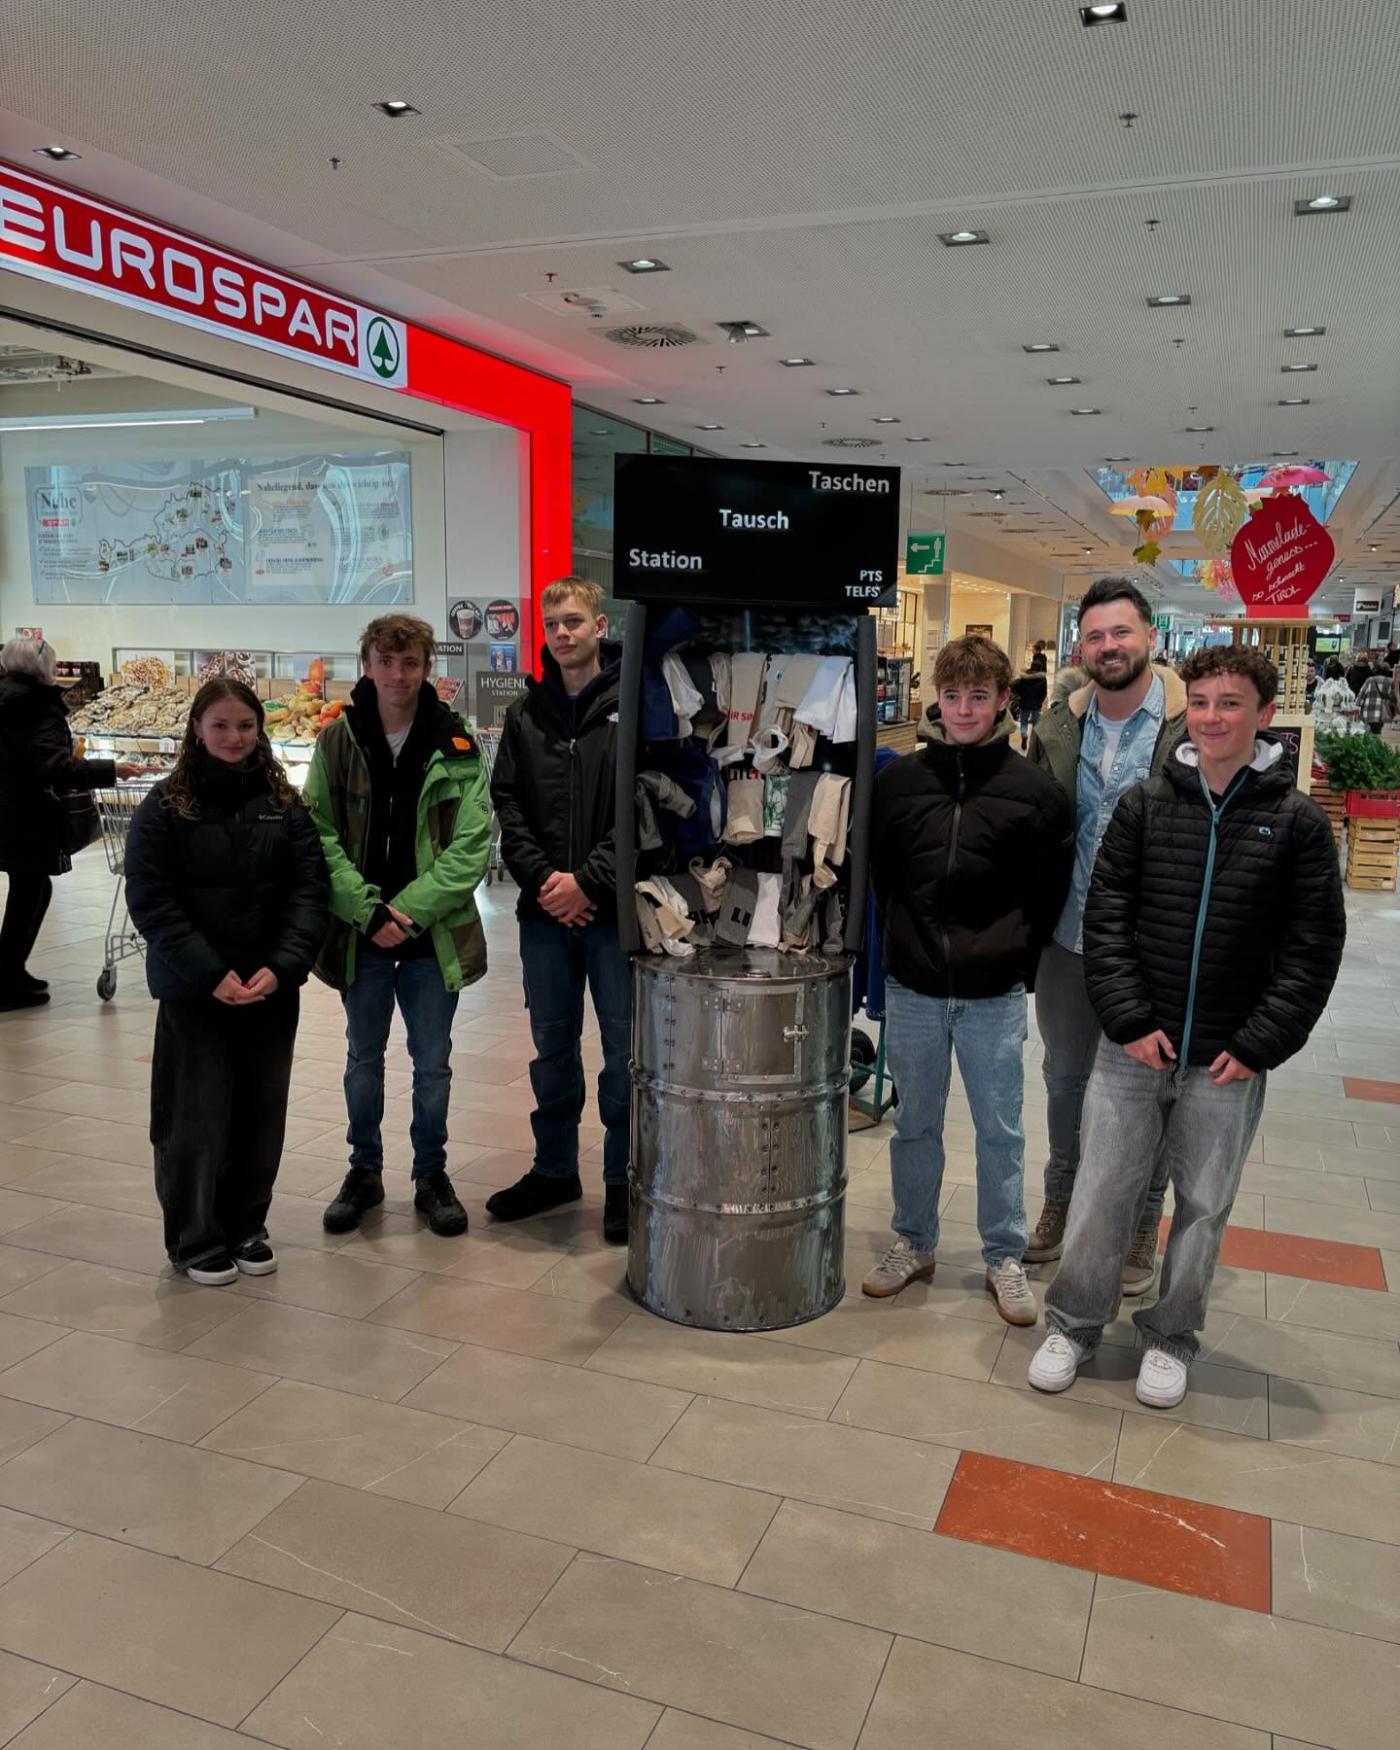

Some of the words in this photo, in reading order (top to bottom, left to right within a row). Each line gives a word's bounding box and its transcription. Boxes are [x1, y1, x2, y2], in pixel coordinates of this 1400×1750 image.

[0, 184, 357, 357] EUROSPAR
[808, 470, 890, 493] Taschen
[719, 509, 789, 530] Tausch
[629, 548, 702, 570] Station
[860, 570, 882, 583] PTS
[845, 585, 880, 598] TELFS
[435, 645, 462, 653] ATION
